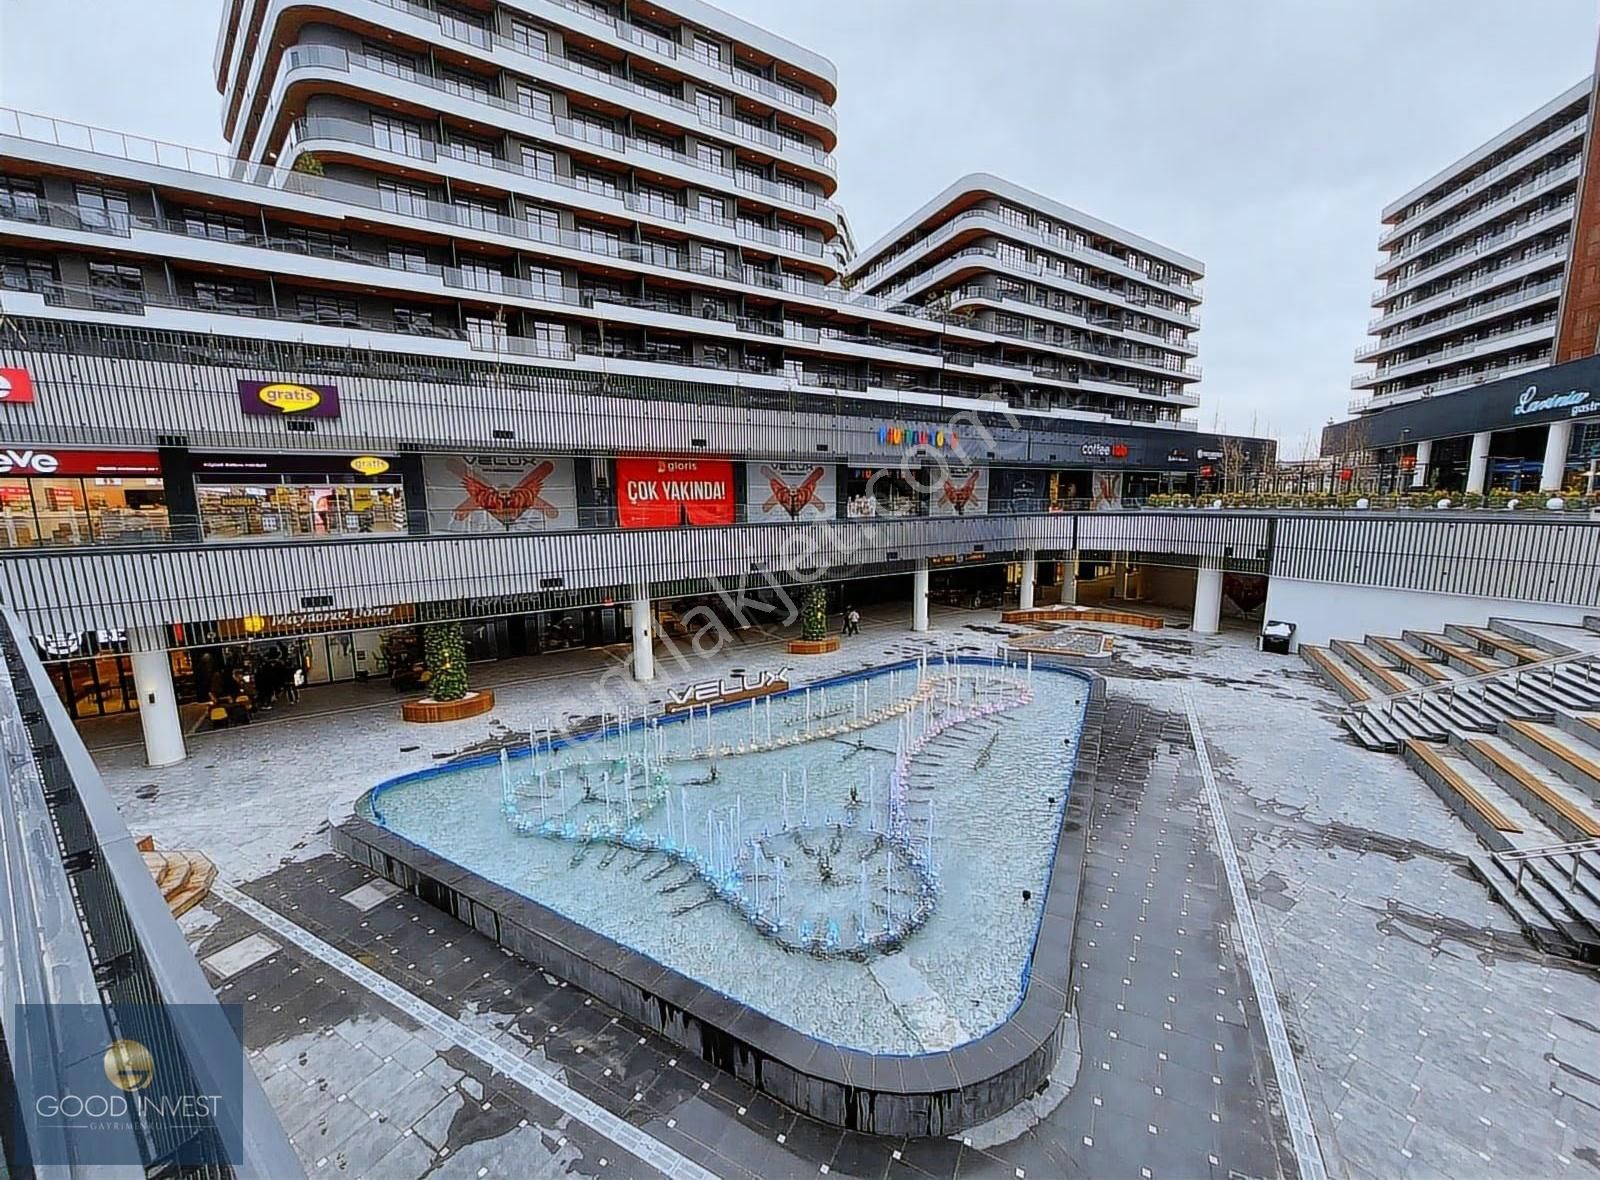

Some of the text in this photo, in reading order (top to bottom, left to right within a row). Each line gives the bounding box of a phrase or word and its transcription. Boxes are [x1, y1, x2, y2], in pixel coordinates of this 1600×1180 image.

[266, 388, 314, 402] gratis
[1082, 443, 1110, 456] coffee
[462, 455, 538, 466] VELUX
[627, 480, 726, 505] ÇOK YAKINDA!
[668, 667, 789, 704] VELUX
